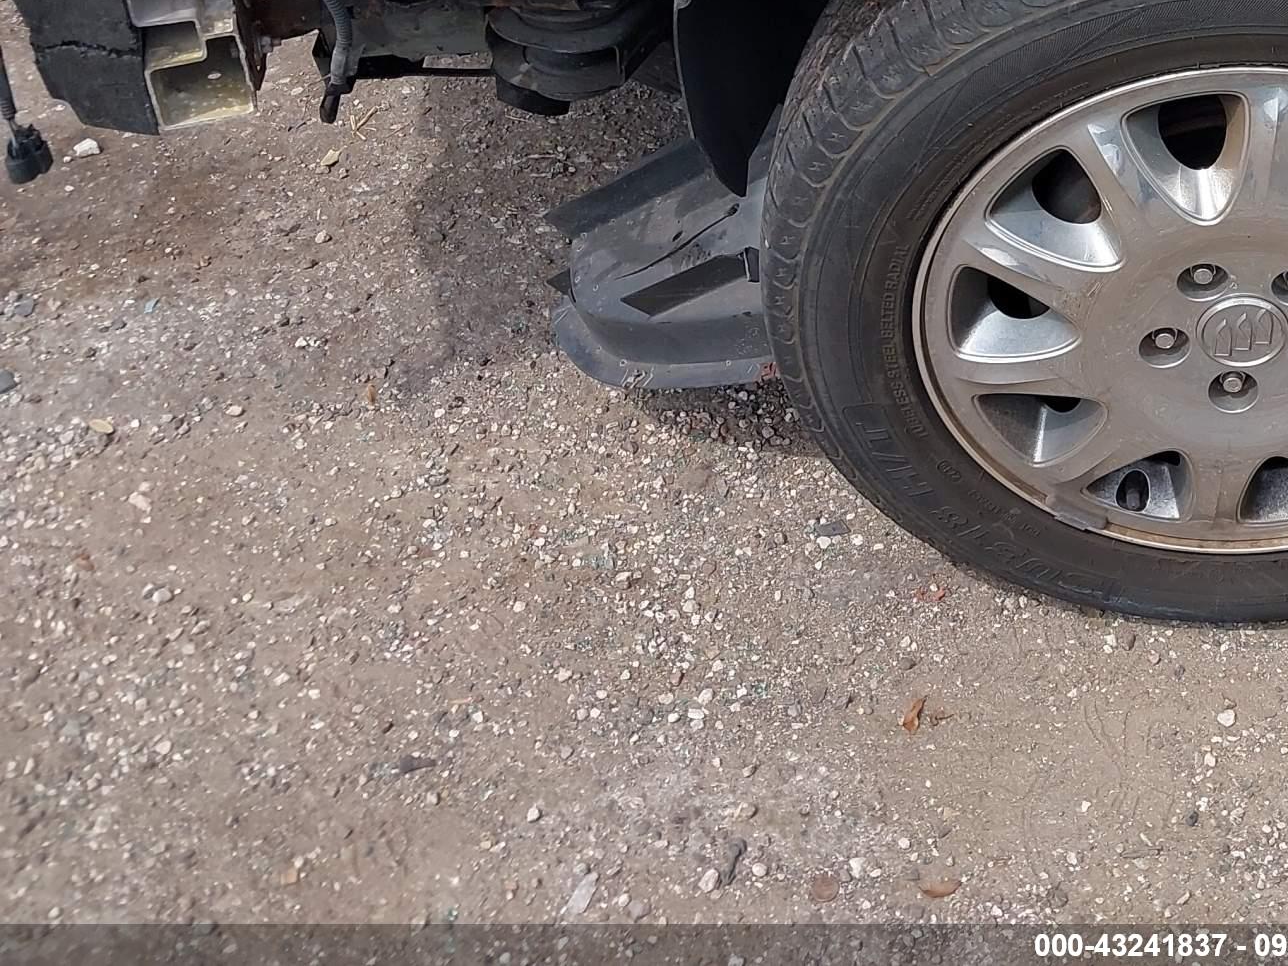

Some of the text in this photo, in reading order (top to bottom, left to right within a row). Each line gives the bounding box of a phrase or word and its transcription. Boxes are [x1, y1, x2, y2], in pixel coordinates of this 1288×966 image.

[878, 240, 932, 440] TUBELESS STEEL BELTED RADIAL
